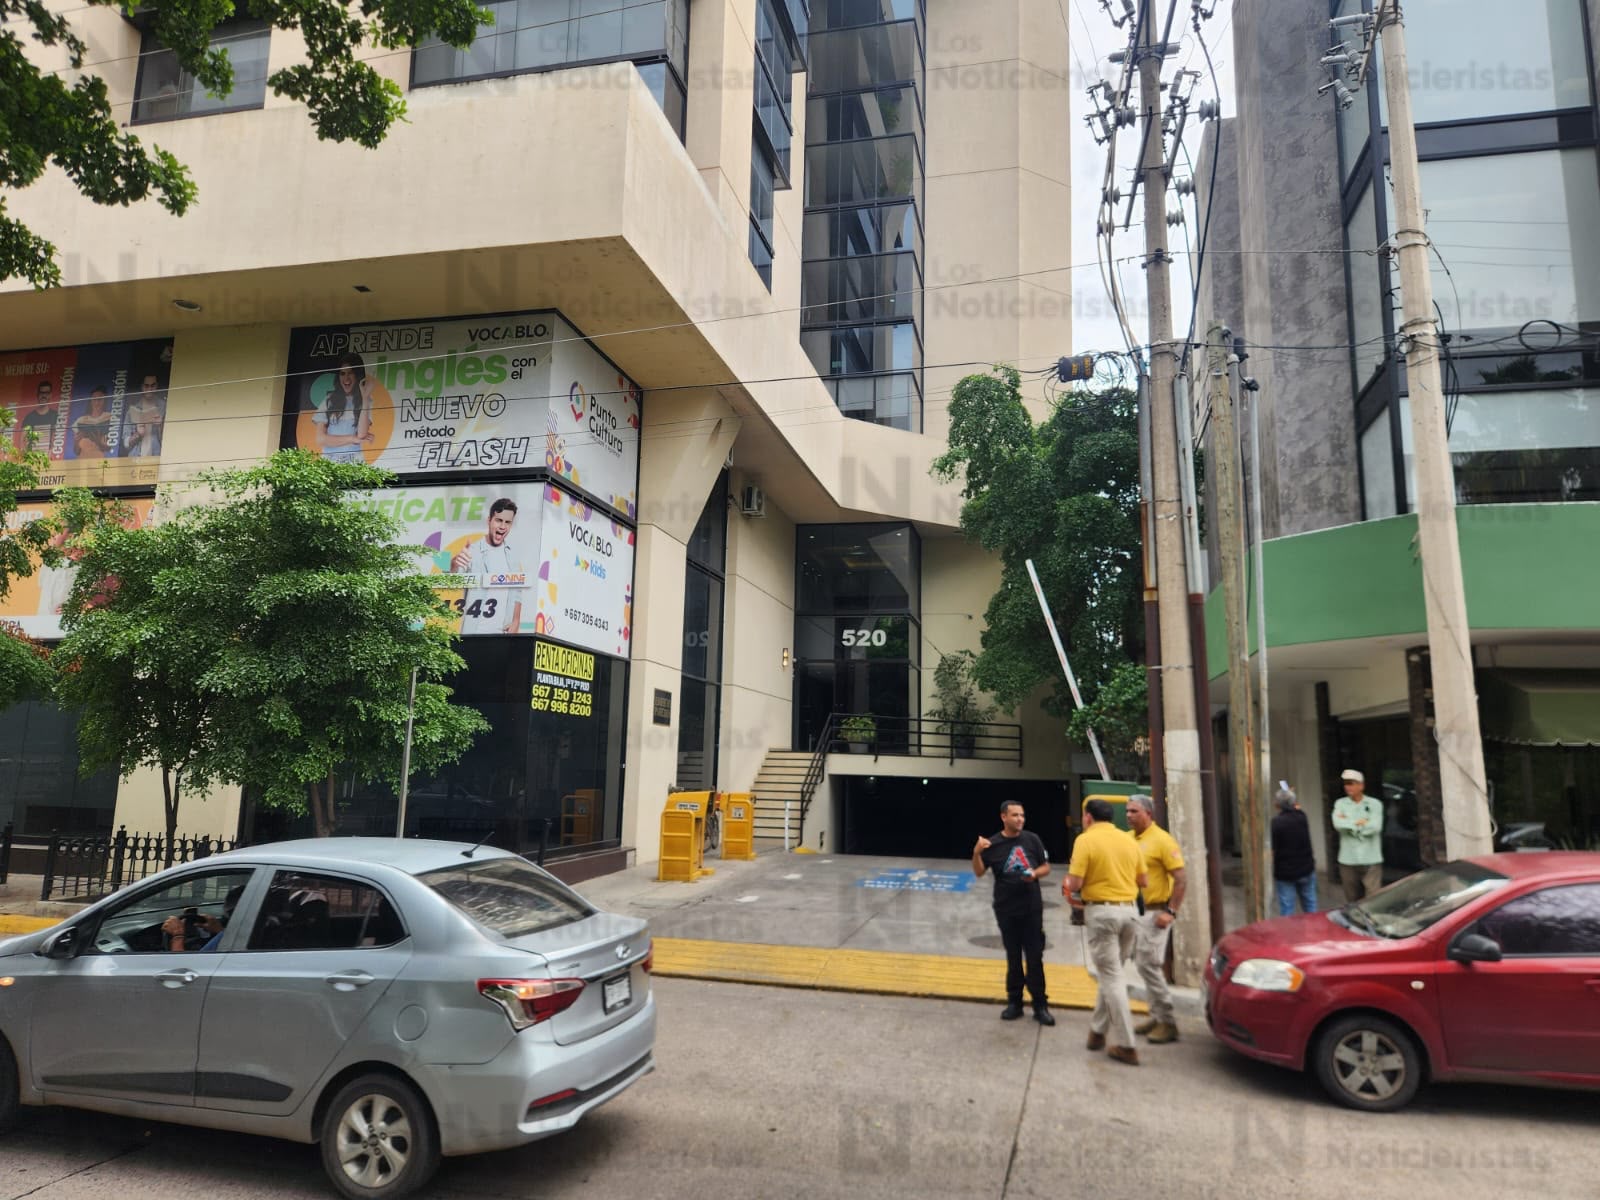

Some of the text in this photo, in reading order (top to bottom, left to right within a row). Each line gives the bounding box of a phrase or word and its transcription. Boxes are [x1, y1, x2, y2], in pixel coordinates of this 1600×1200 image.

[311, 327, 434, 357] APRENDE
[7, 363, 34, 377] MEJORE
[376, 344, 507, 399] inglés
[511, 368, 522, 380] el
[512, 358, 536, 368] con
[52, 367, 75, 456] CONCENTRACIÓN
[107, 369, 128, 446] COMPRENSIÓN
[401, 393, 507, 422] NUEVO
[590, 394, 617, 430] Punto
[404, 426, 455, 439] método
[589, 416, 623, 453] Cultura
[418, 437, 530, 468] FLASH
[569, 521, 613, 558] VOCABLO
[590, 559, 606, 579] kids
[569, 608, 609, 631] 667 305 4343
[841, 629, 887, 647] 520
[535, 643, 593, 679] RENTA OFICINAS
[532, 684, 592, 704] 667 150 1243
[537, 672, 553, 685] PLANTA
[580, 681, 590, 692] PISO
[531, 698, 592, 717] 667 996 8200
